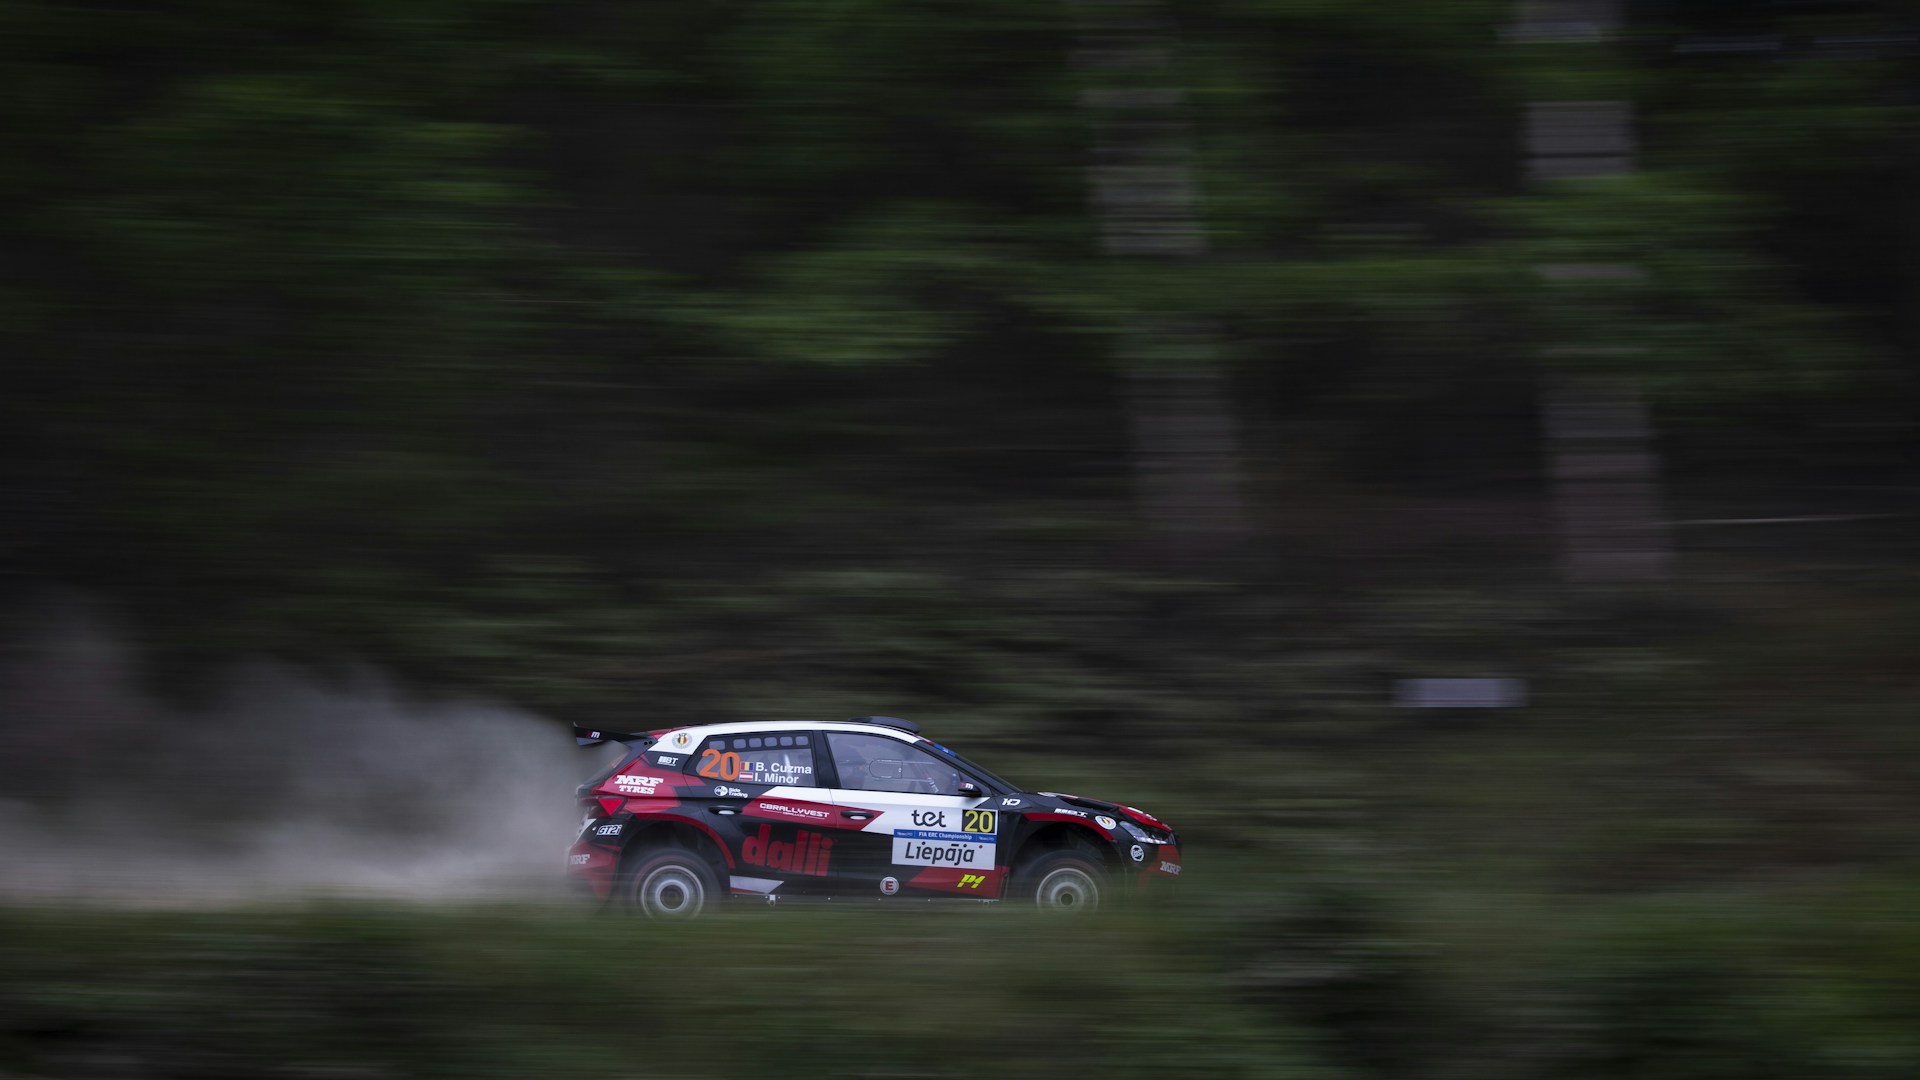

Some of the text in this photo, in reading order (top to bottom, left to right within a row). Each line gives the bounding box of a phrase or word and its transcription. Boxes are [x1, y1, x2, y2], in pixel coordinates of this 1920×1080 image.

[699, 748, 740, 781] 20
[755, 762, 812, 775] B. Cuzma
[614, 774, 664, 787] MRF
[754, 773, 799, 784] I. Minor
[619, 785, 655, 795] TYRES
[759, 803, 830, 818] CBRALLYVEST
[911, 810, 947, 828] tet
[964, 810, 994, 834] 20
[939, 833, 973, 841] Championship
[742, 824, 833, 877] dalli
[905, 841, 975, 866] Liepāja
[569, 853, 591, 865] MRF
[1159, 861, 1182, 876] MRF
[885, 880, 894, 890] E
